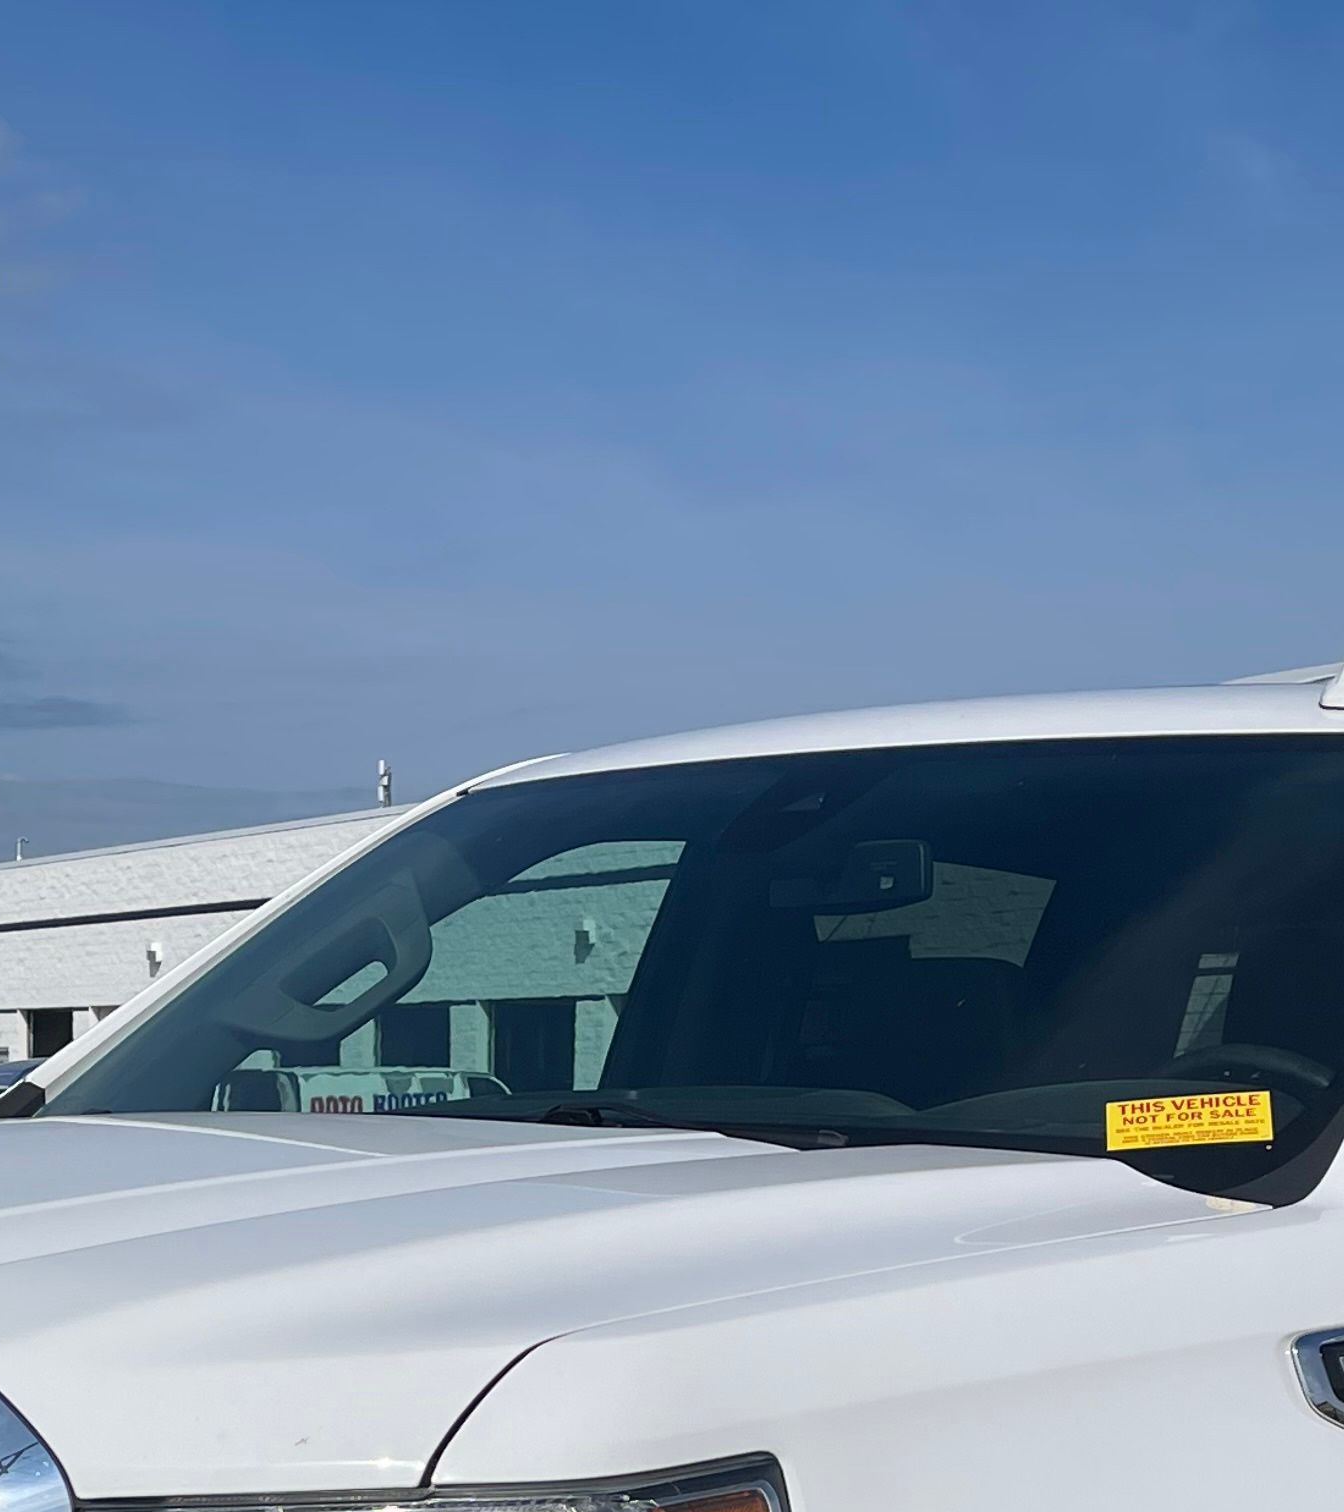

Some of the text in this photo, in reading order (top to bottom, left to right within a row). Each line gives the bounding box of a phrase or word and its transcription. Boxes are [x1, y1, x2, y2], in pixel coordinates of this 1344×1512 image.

[1118, 1094, 1261, 1116] THIS VEHICLE
[1122, 1107, 1257, 1126] NOT FOR SALE
